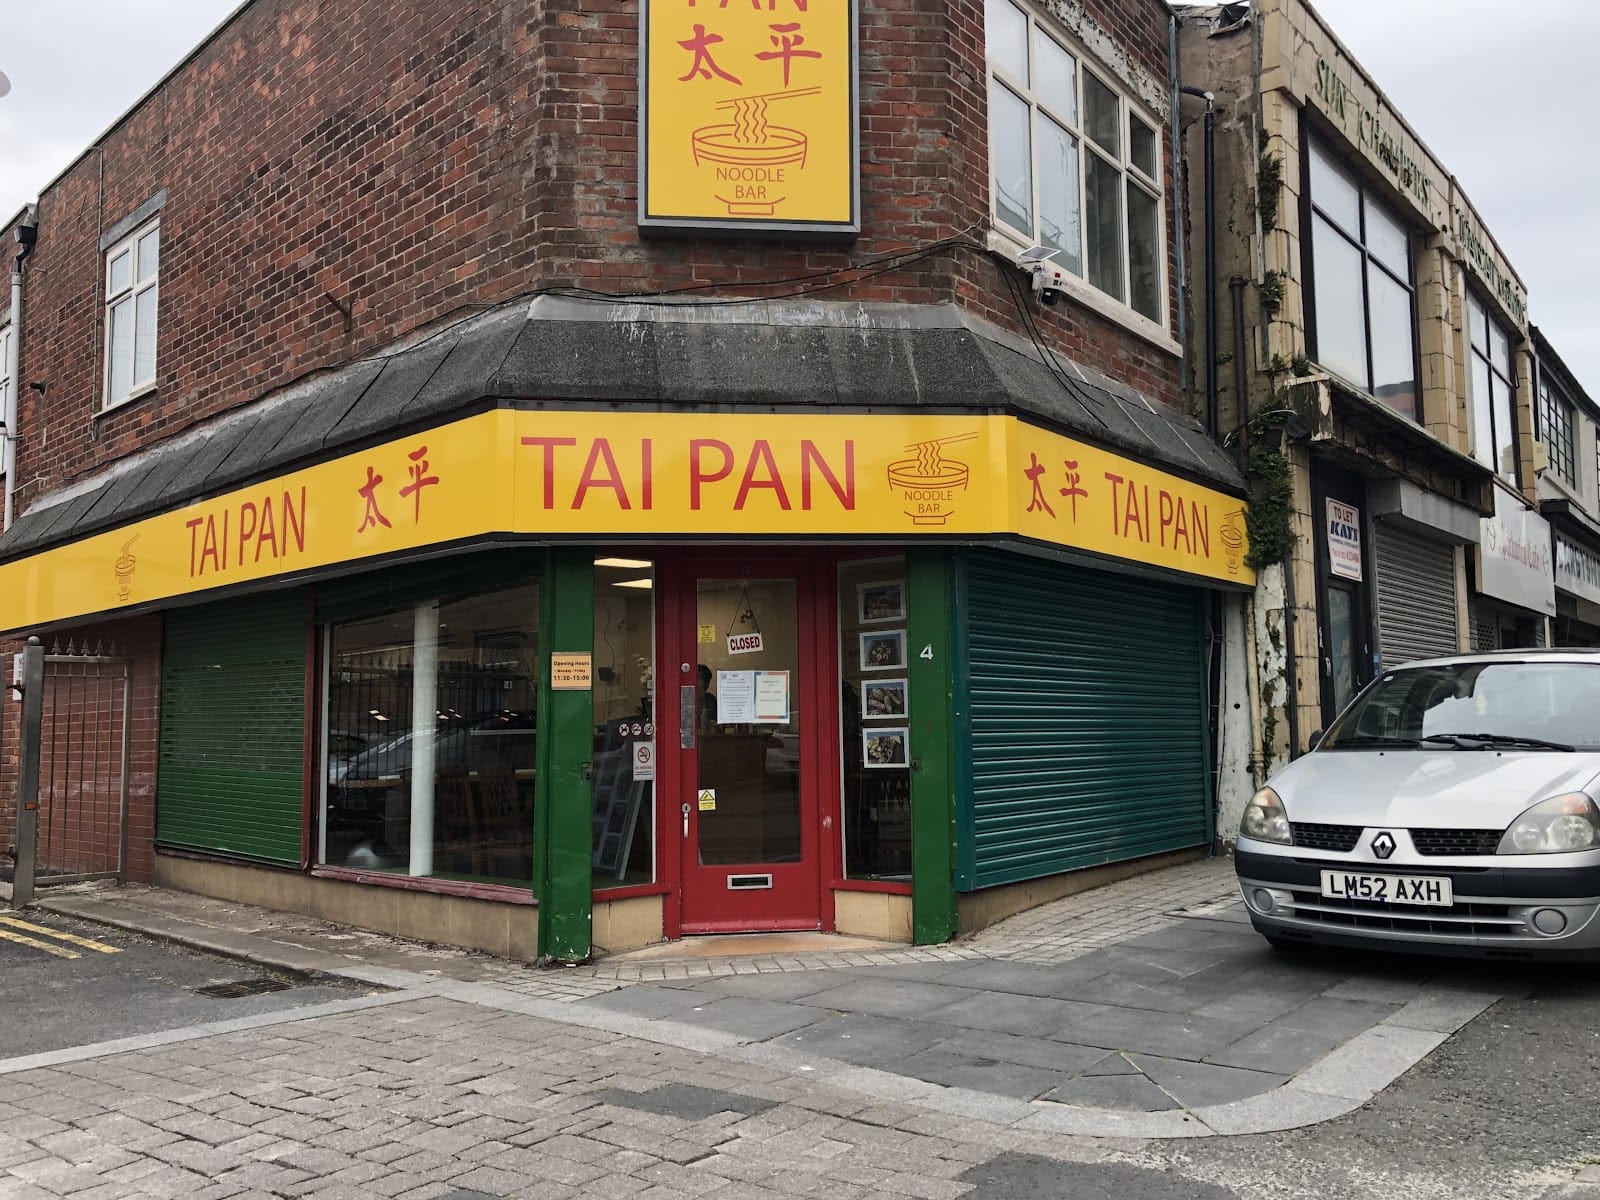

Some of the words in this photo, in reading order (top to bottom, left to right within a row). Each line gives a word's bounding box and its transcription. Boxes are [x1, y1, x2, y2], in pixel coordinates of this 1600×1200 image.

[677, 22, 822, 88] 太平
[1315, 57, 1346, 120] SUN
[716, 167, 785, 182] NOODLE
[735, 185, 767, 199] BAR
[521, 437, 653, 510] TAI
[690, 439, 855, 511] PAN
[357, 446, 440, 534] 太平
[904, 490, 953, 501] NOODLE
[1024, 452, 1088, 526] 太平
[918, 504, 941, 514] BAR
[1105, 472, 1150, 543] TAI
[1159, 491, 1210, 559] PAN
[1333, 506, 1342, 519] TO
[1342, 510, 1353, 524] LET
[186, 509, 229, 577] TAI
[239, 486, 306, 566] PAN
[730, 638, 760, 651] CLOSED
[921, 644, 934, 660] 4
[1330, 874, 1388, 898] LM52
[1395, 879, 1441, 902] AXH
